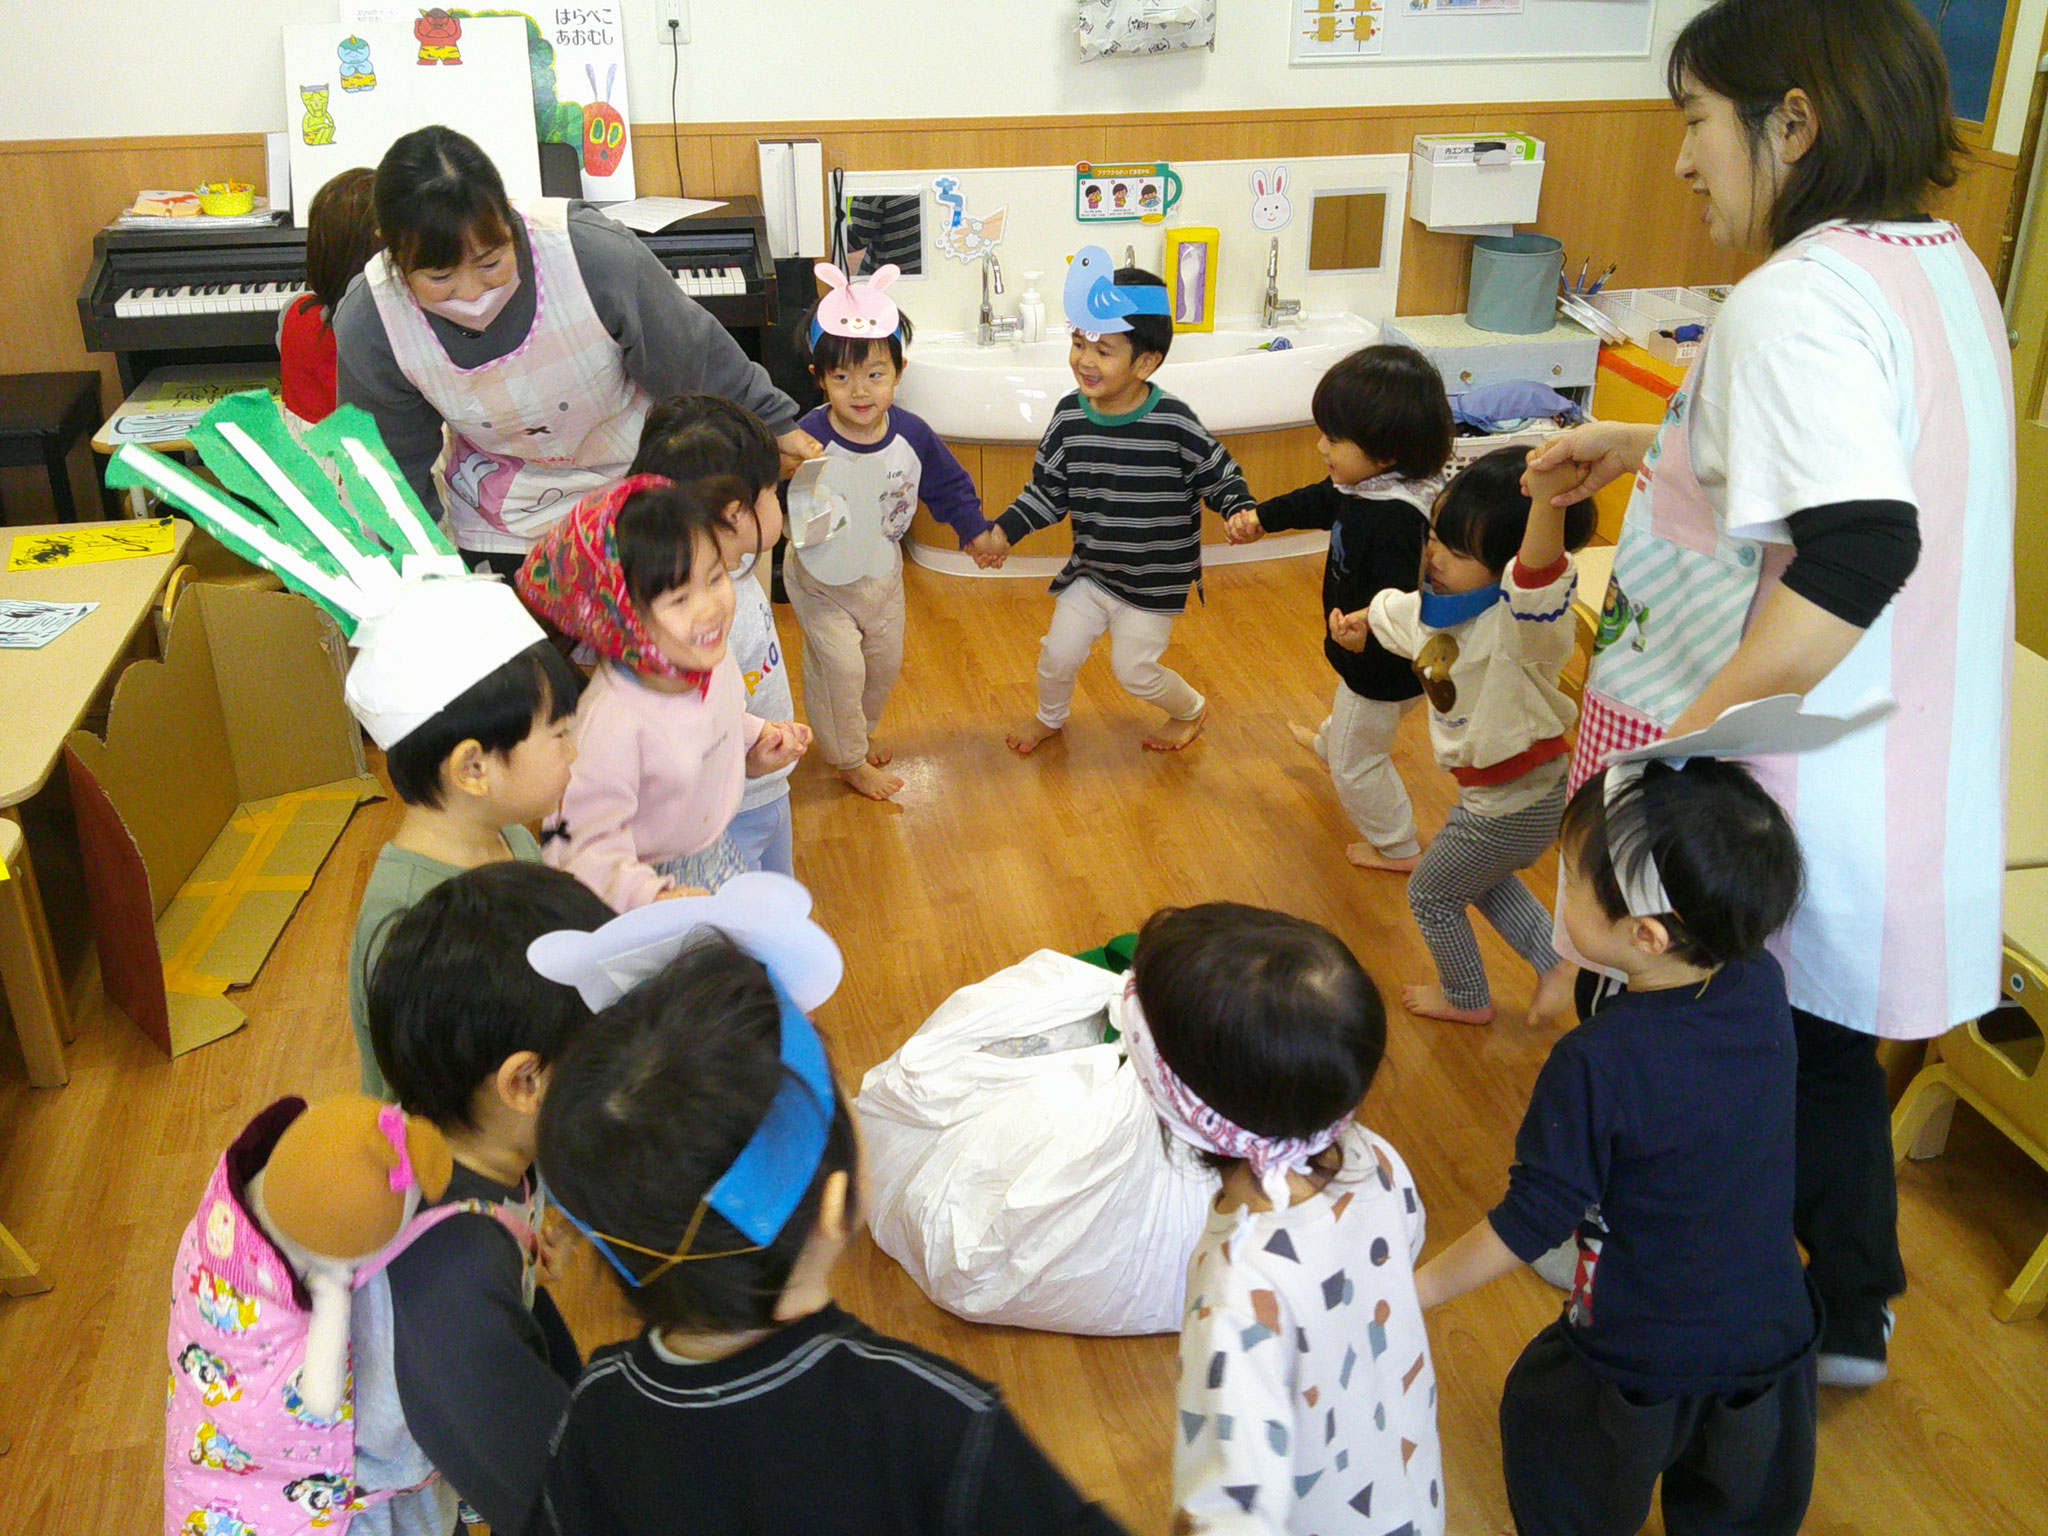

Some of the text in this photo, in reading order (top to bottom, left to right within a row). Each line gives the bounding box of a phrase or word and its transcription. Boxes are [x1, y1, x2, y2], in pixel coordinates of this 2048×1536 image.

[555, 8, 613, 25] はらぺこ
[555, 29, 614, 46] あおむし
